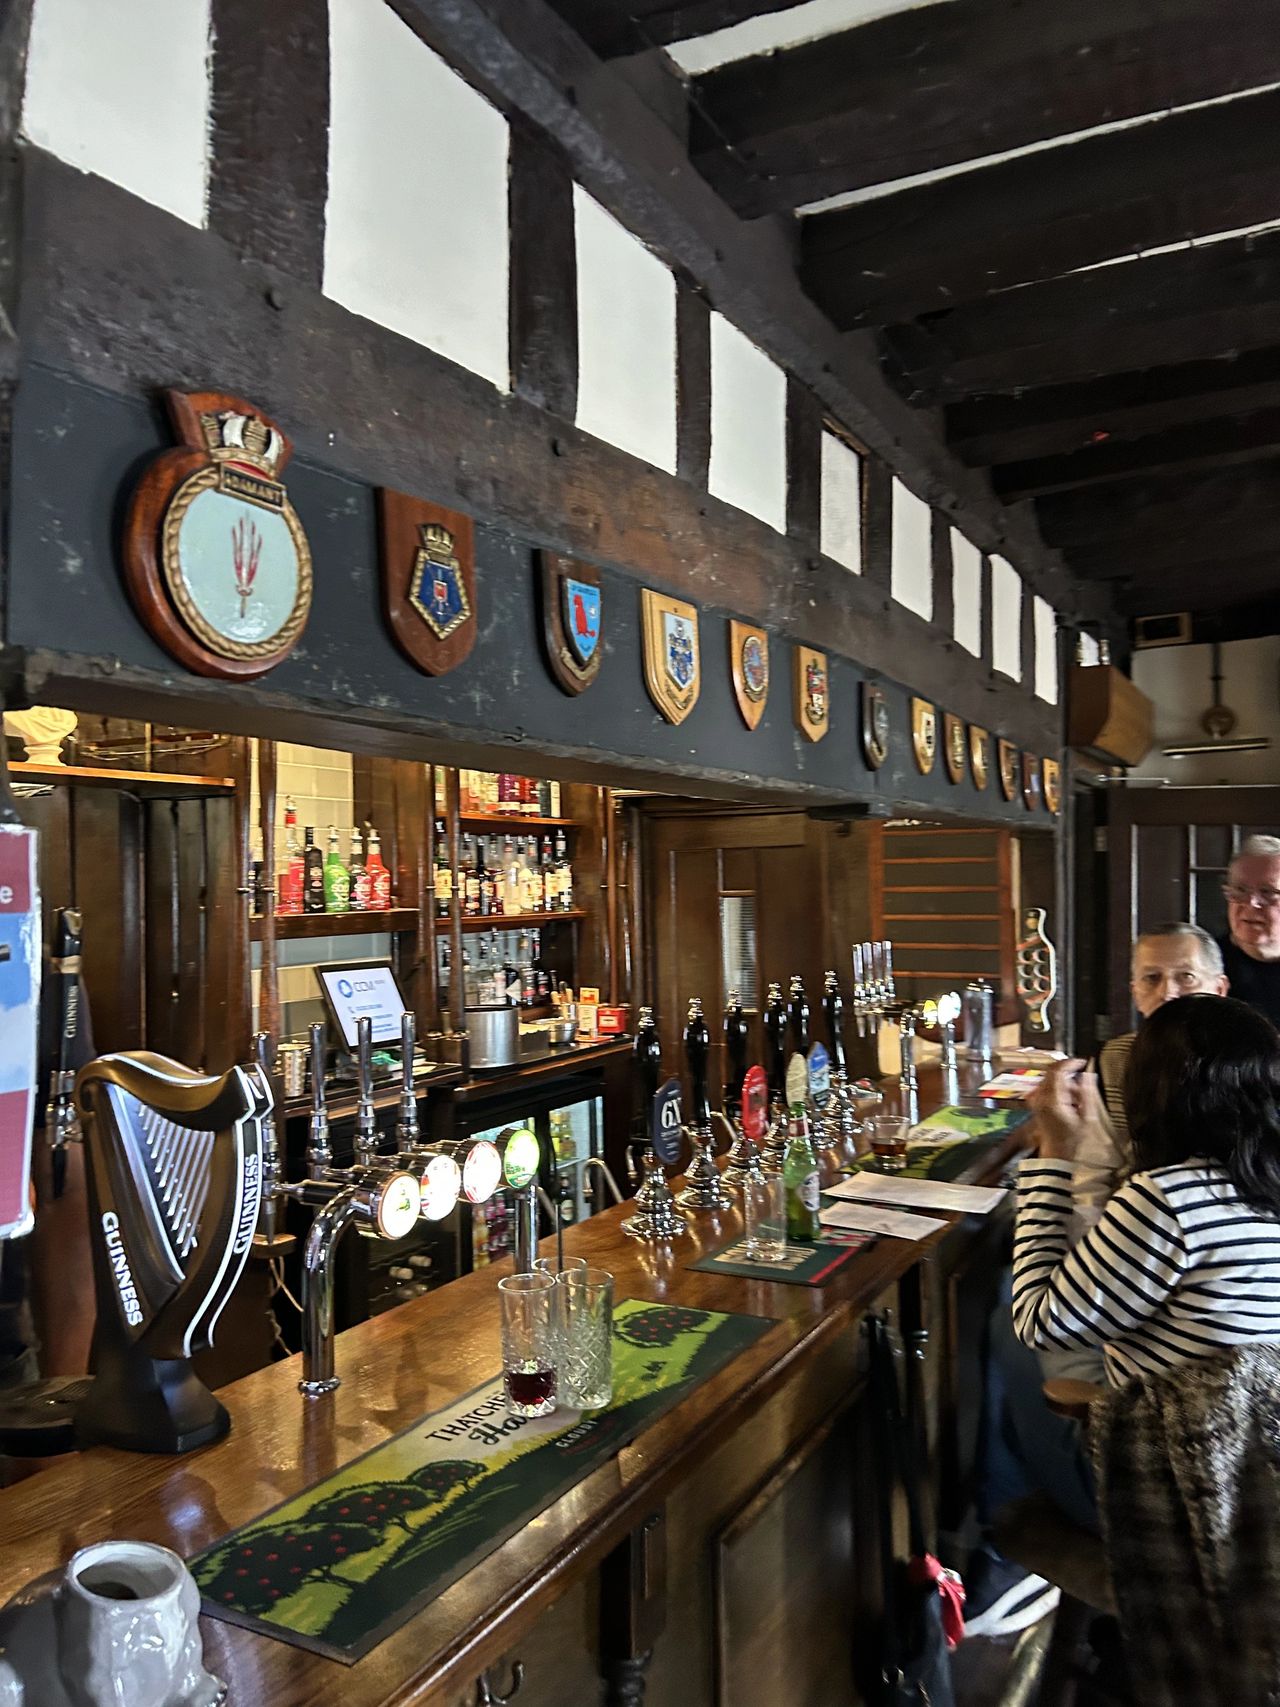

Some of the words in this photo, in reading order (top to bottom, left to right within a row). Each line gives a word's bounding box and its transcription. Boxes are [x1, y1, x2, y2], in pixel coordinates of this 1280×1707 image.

[233, 1153, 258, 1254] GUINNESS
[102, 1211, 144, 1326] GUINNESS
[424, 1392, 506, 1442] THATCHE
